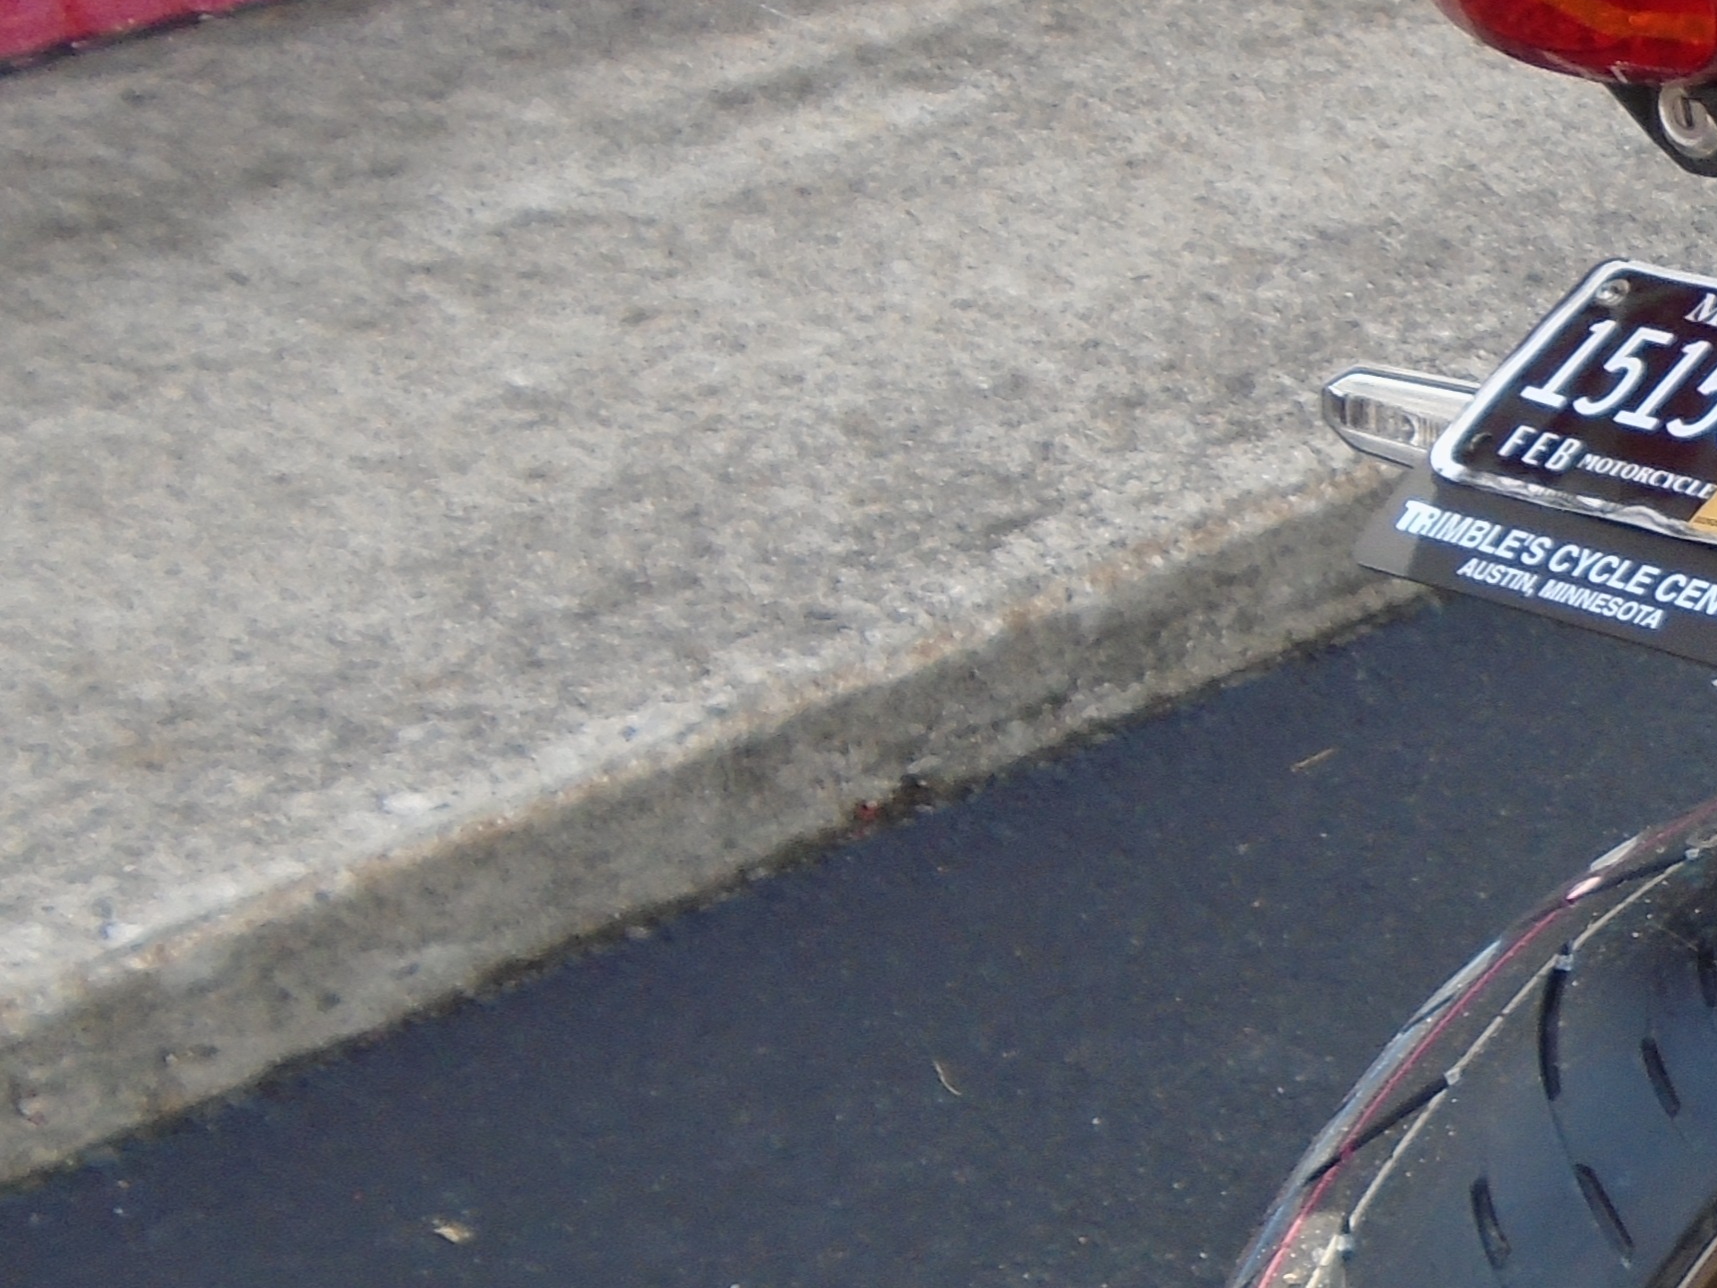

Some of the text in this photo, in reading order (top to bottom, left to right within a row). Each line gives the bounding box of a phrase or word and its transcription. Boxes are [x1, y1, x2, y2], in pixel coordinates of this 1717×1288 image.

[1497, 425, 1581, 473] FEB
[1395, 500, 1551, 565] TRIMBLE'S
[1548, 543, 1663, 595] CYCLE
[1457, 558, 1664, 630] AUSTIN, MINNESOTA
